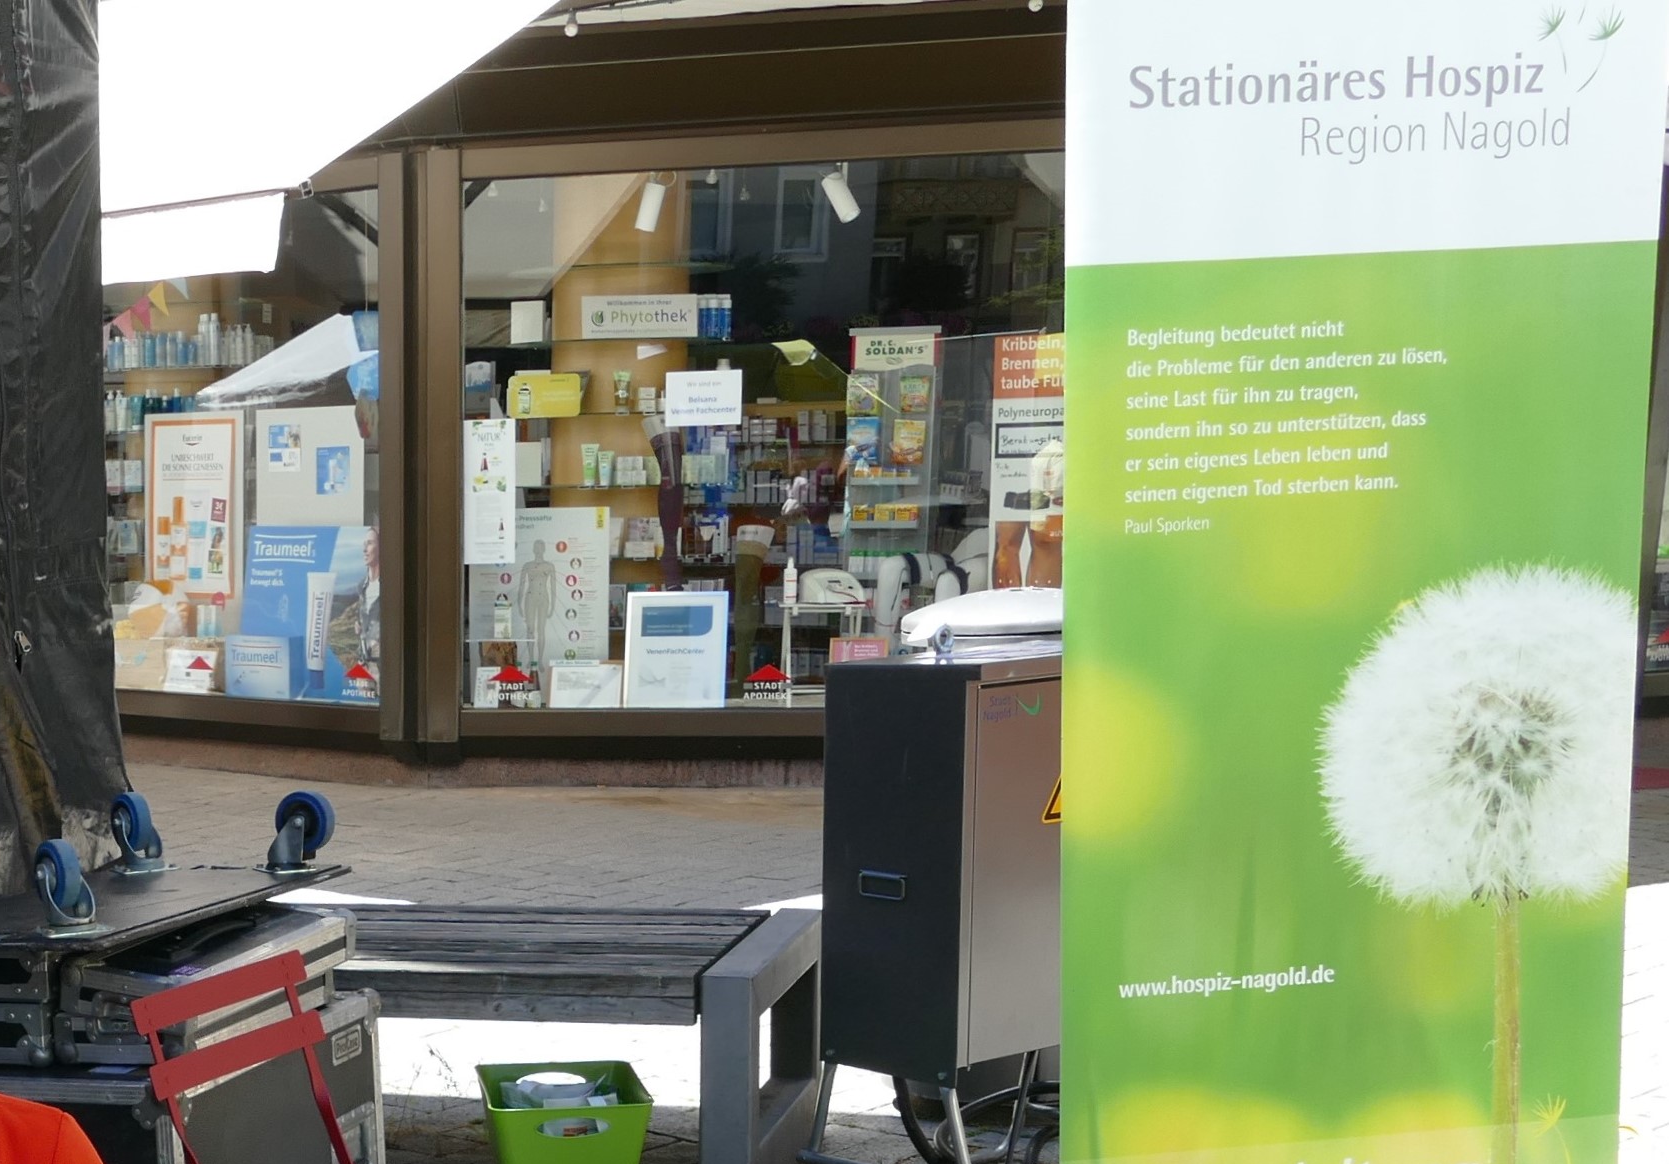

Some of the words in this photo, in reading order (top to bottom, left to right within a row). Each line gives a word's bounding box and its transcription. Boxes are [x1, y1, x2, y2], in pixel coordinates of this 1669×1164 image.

[1128, 60, 1387, 109] Stationäres
[1403, 52, 1545, 108] Hospiz
[1298, 113, 1427, 166] Region
[1441, 106, 1572, 159] Nagold
[611, 308, 688, 327] Phytothek
[1127, 327, 1215, 351] Begleitung
[1220, 323, 1295, 343] bedeutet
[1301, 320, 1345, 339] nicht
[1001, 357, 1064, 371] Brennen,
[1126, 360, 1152, 379] die
[1157, 358, 1233, 377] Probleme
[1238, 355, 1265, 374] für
[1269, 353, 1300, 372] den
[1305, 350, 1373, 370] anderen
[1377, 351, 1397, 367] zu
[1401, 347, 1448, 366] lösen,
[1000, 375, 1040, 390] taube
[1126, 392, 1169, 410] seine
[1174, 389, 1207, 408] Last
[1212, 387, 1238, 407] für
[1243, 386, 1270, 404] ihn
[1275, 387, 1294, 403] zu
[1298, 383, 1359, 406] tragen,
[1125, 422, 1191, 442] sondern
[1195, 420, 1223, 438] ihn
[1228, 422, 1248, 437] so
[1252, 420, 1272, 435] zu
[1277, 412, 1387, 434] unterstützen,
[1391, 410, 1427, 428] dass
[1125, 457, 1142, 473] er
[1147, 453, 1179, 472] sein
[1184, 451, 1248, 474] eigenes
[1253, 446, 1301, 466] Leben
[1306, 444, 1352, 464] leben
[1356, 442, 1389, 461] und
[1124, 485, 1178, 504] seinen
[1182, 482, 1248, 505] eigenen
[1253, 477, 1282, 498] Tod
[1287, 475, 1350, 496] sterben
[1354, 473, 1400, 492] kann.
[1124, 517, 1154, 535] Paul
[1156, 516, 1210, 537] Sporken
[253, 540, 312, 558] Traumeel
[310, 595, 325, 660] Traumeel
[231, 649, 280, 665] Traumeel
[487, 692, 533, 701] APOTHEKE
[497, 682, 524, 691] STADT
[753, 682, 782, 691] STADT
[1118, 964, 1336, 998] www.hospiz-nagold.de
